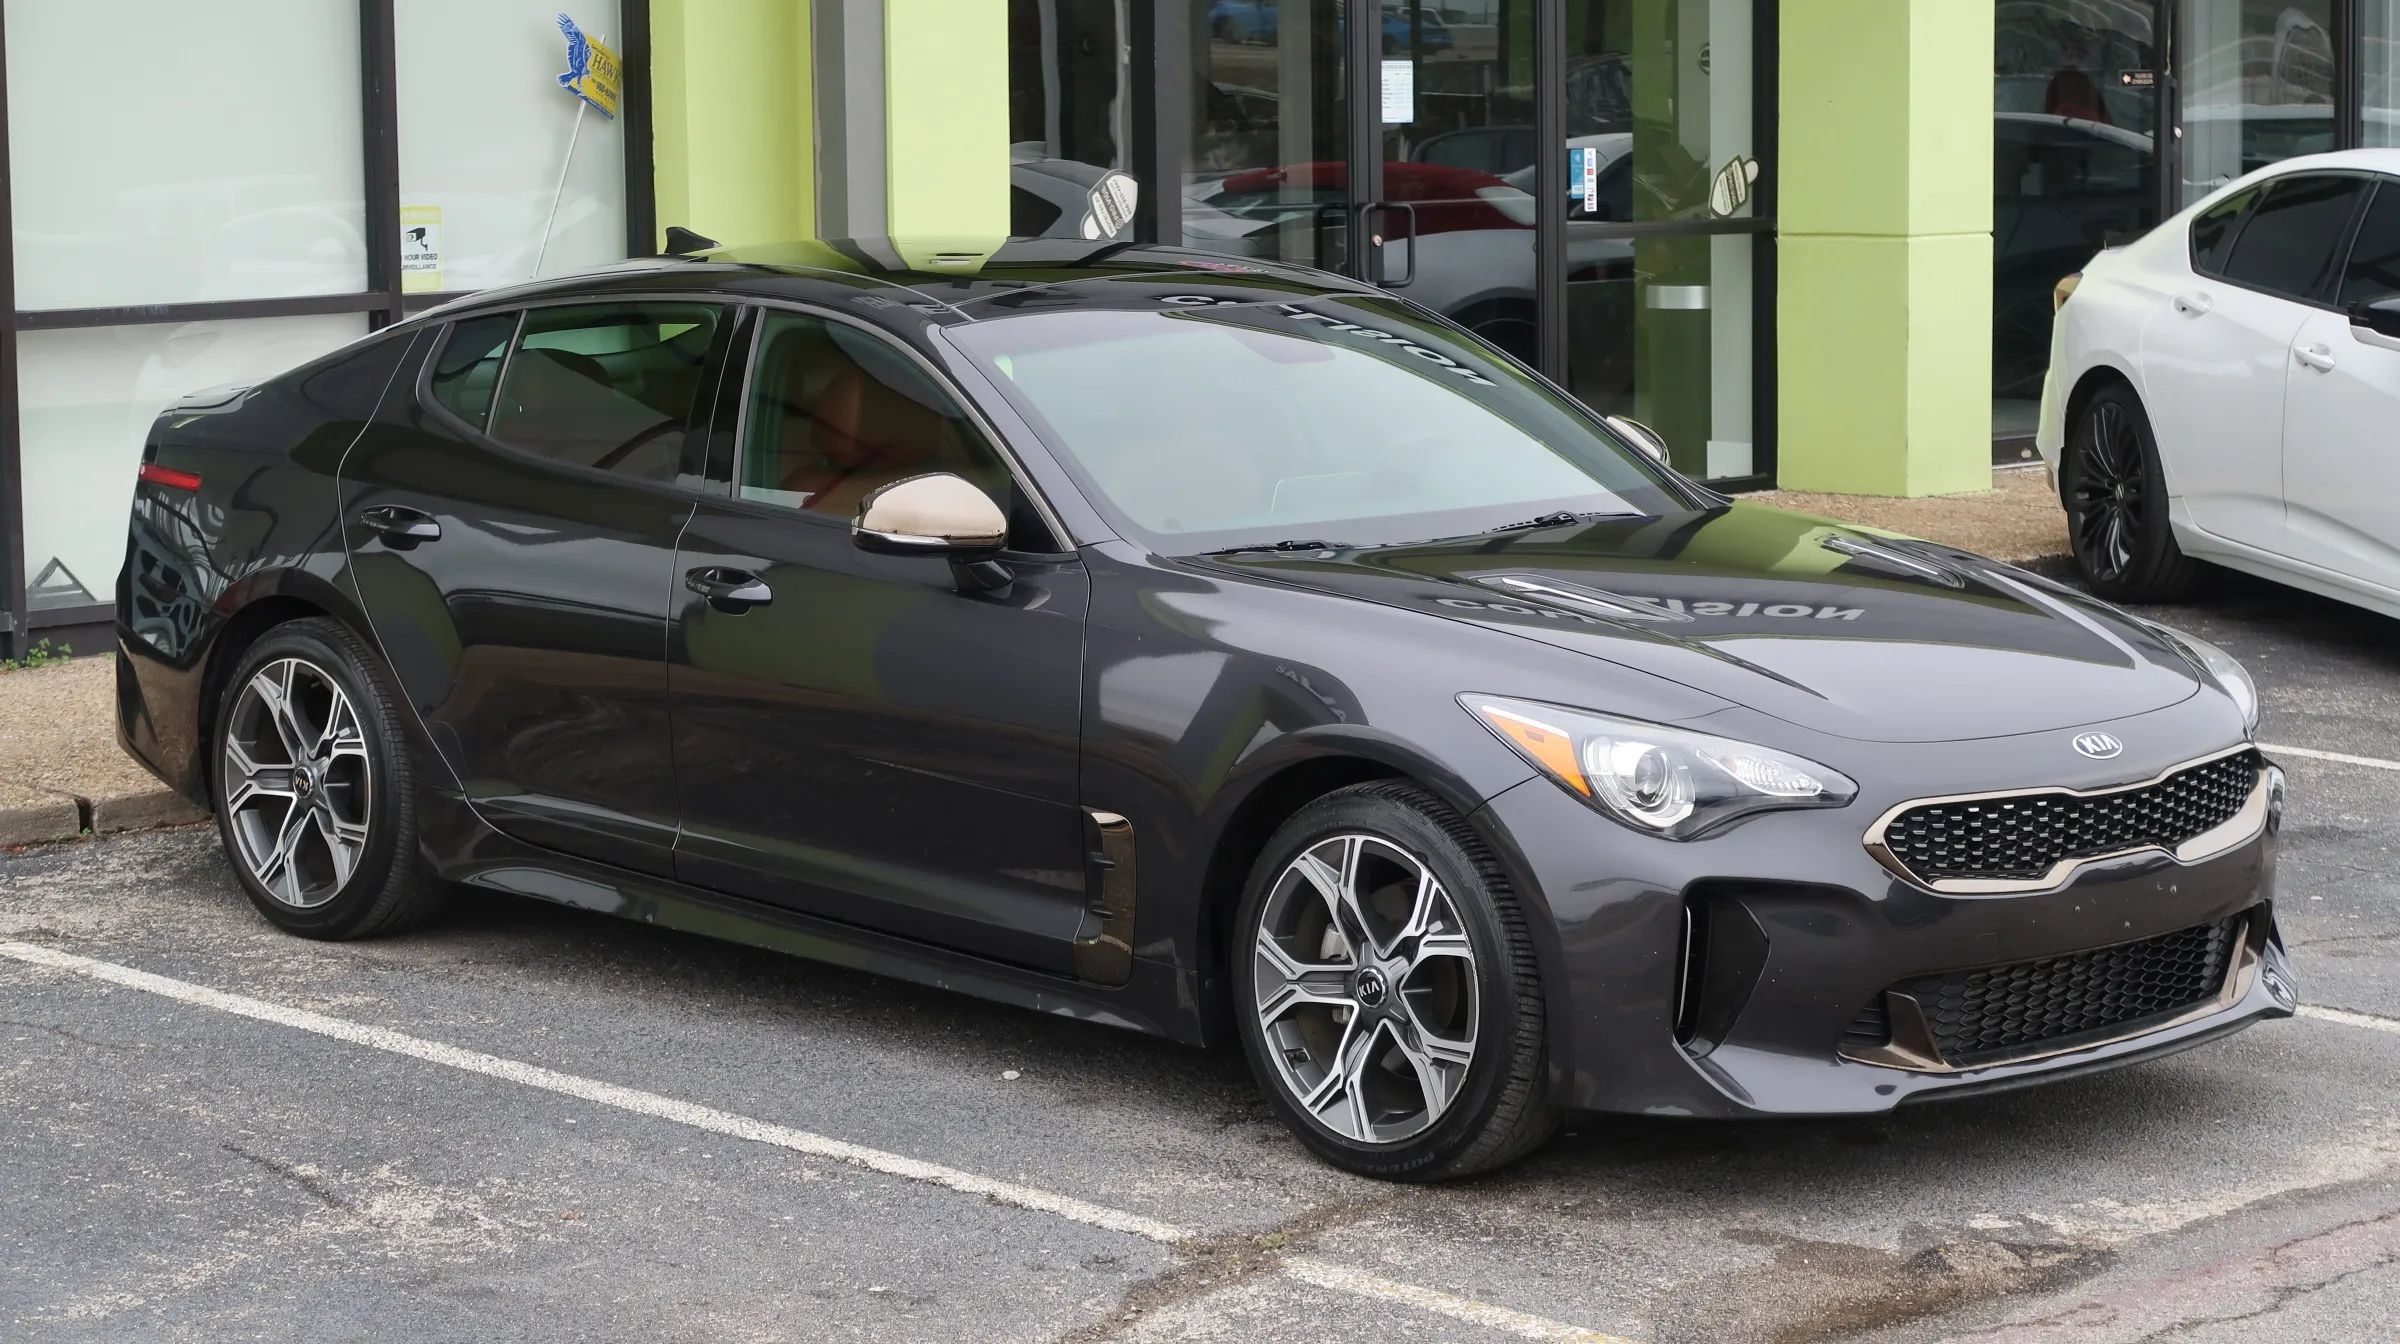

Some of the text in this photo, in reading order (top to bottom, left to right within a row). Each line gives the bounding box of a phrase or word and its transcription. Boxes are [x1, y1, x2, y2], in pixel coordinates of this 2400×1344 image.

[420, 253, 438, 261] VIDEO
[2078, 734, 2119, 754] KIA
[295, 775, 309, 791] KIA
[1358, 980, 1380, 996] KIA
